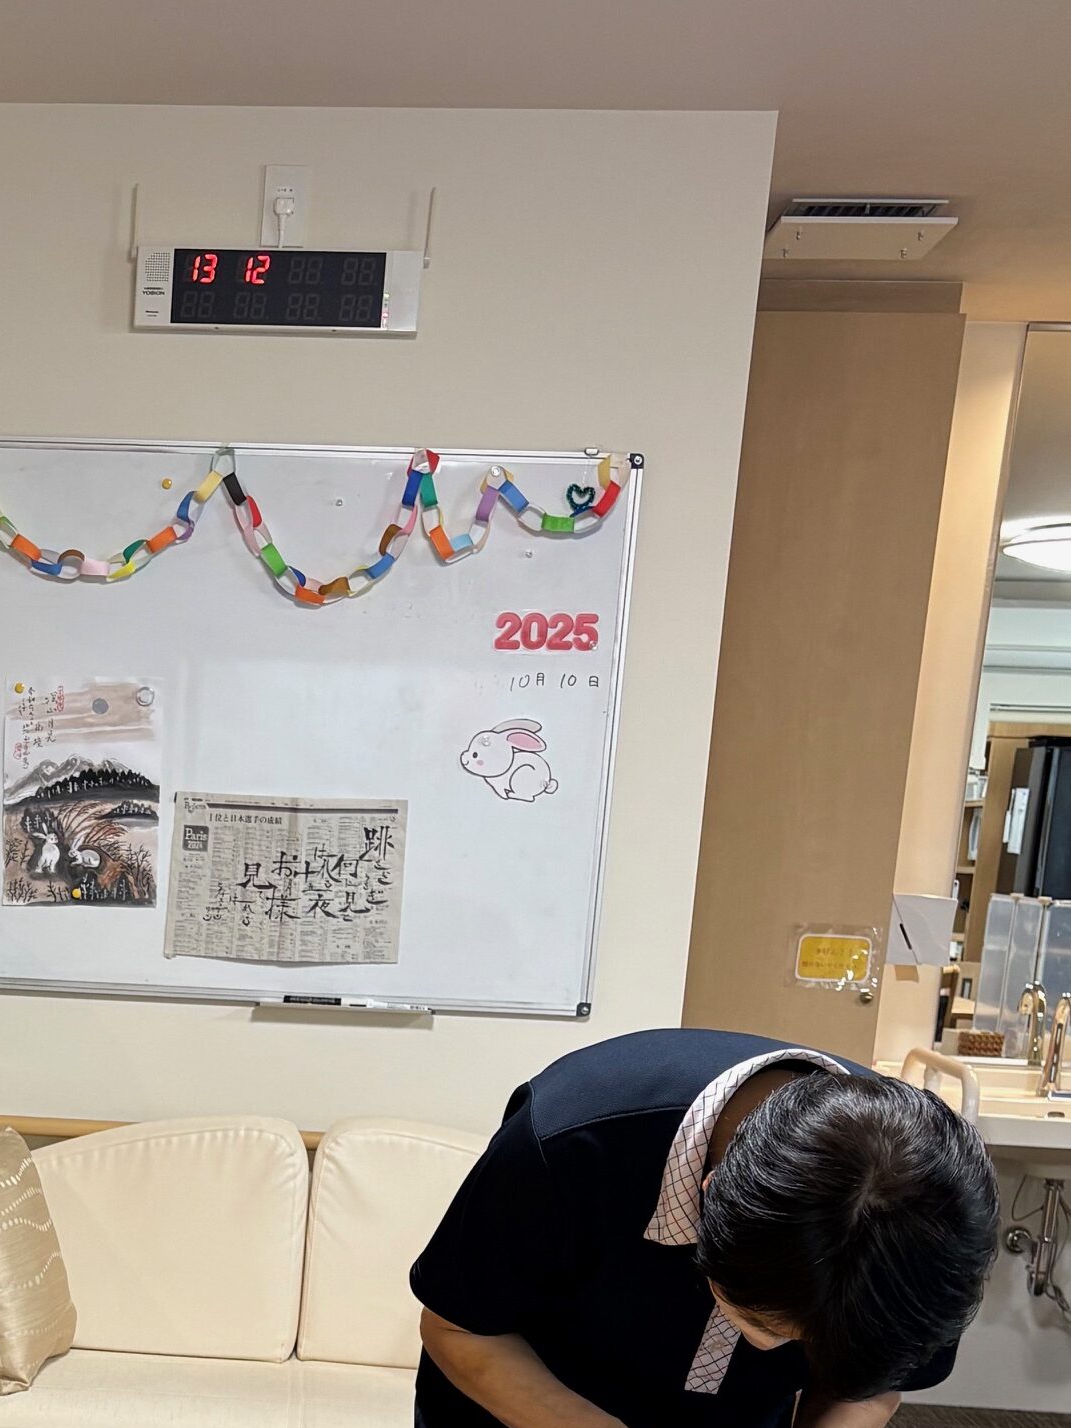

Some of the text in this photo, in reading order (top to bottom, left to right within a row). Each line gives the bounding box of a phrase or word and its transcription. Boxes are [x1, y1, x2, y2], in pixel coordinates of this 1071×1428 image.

[191, 253, 271, 285] 13 12
[493, 610, 600, 653] 2025
[185, 827, 209, 842] Paris
